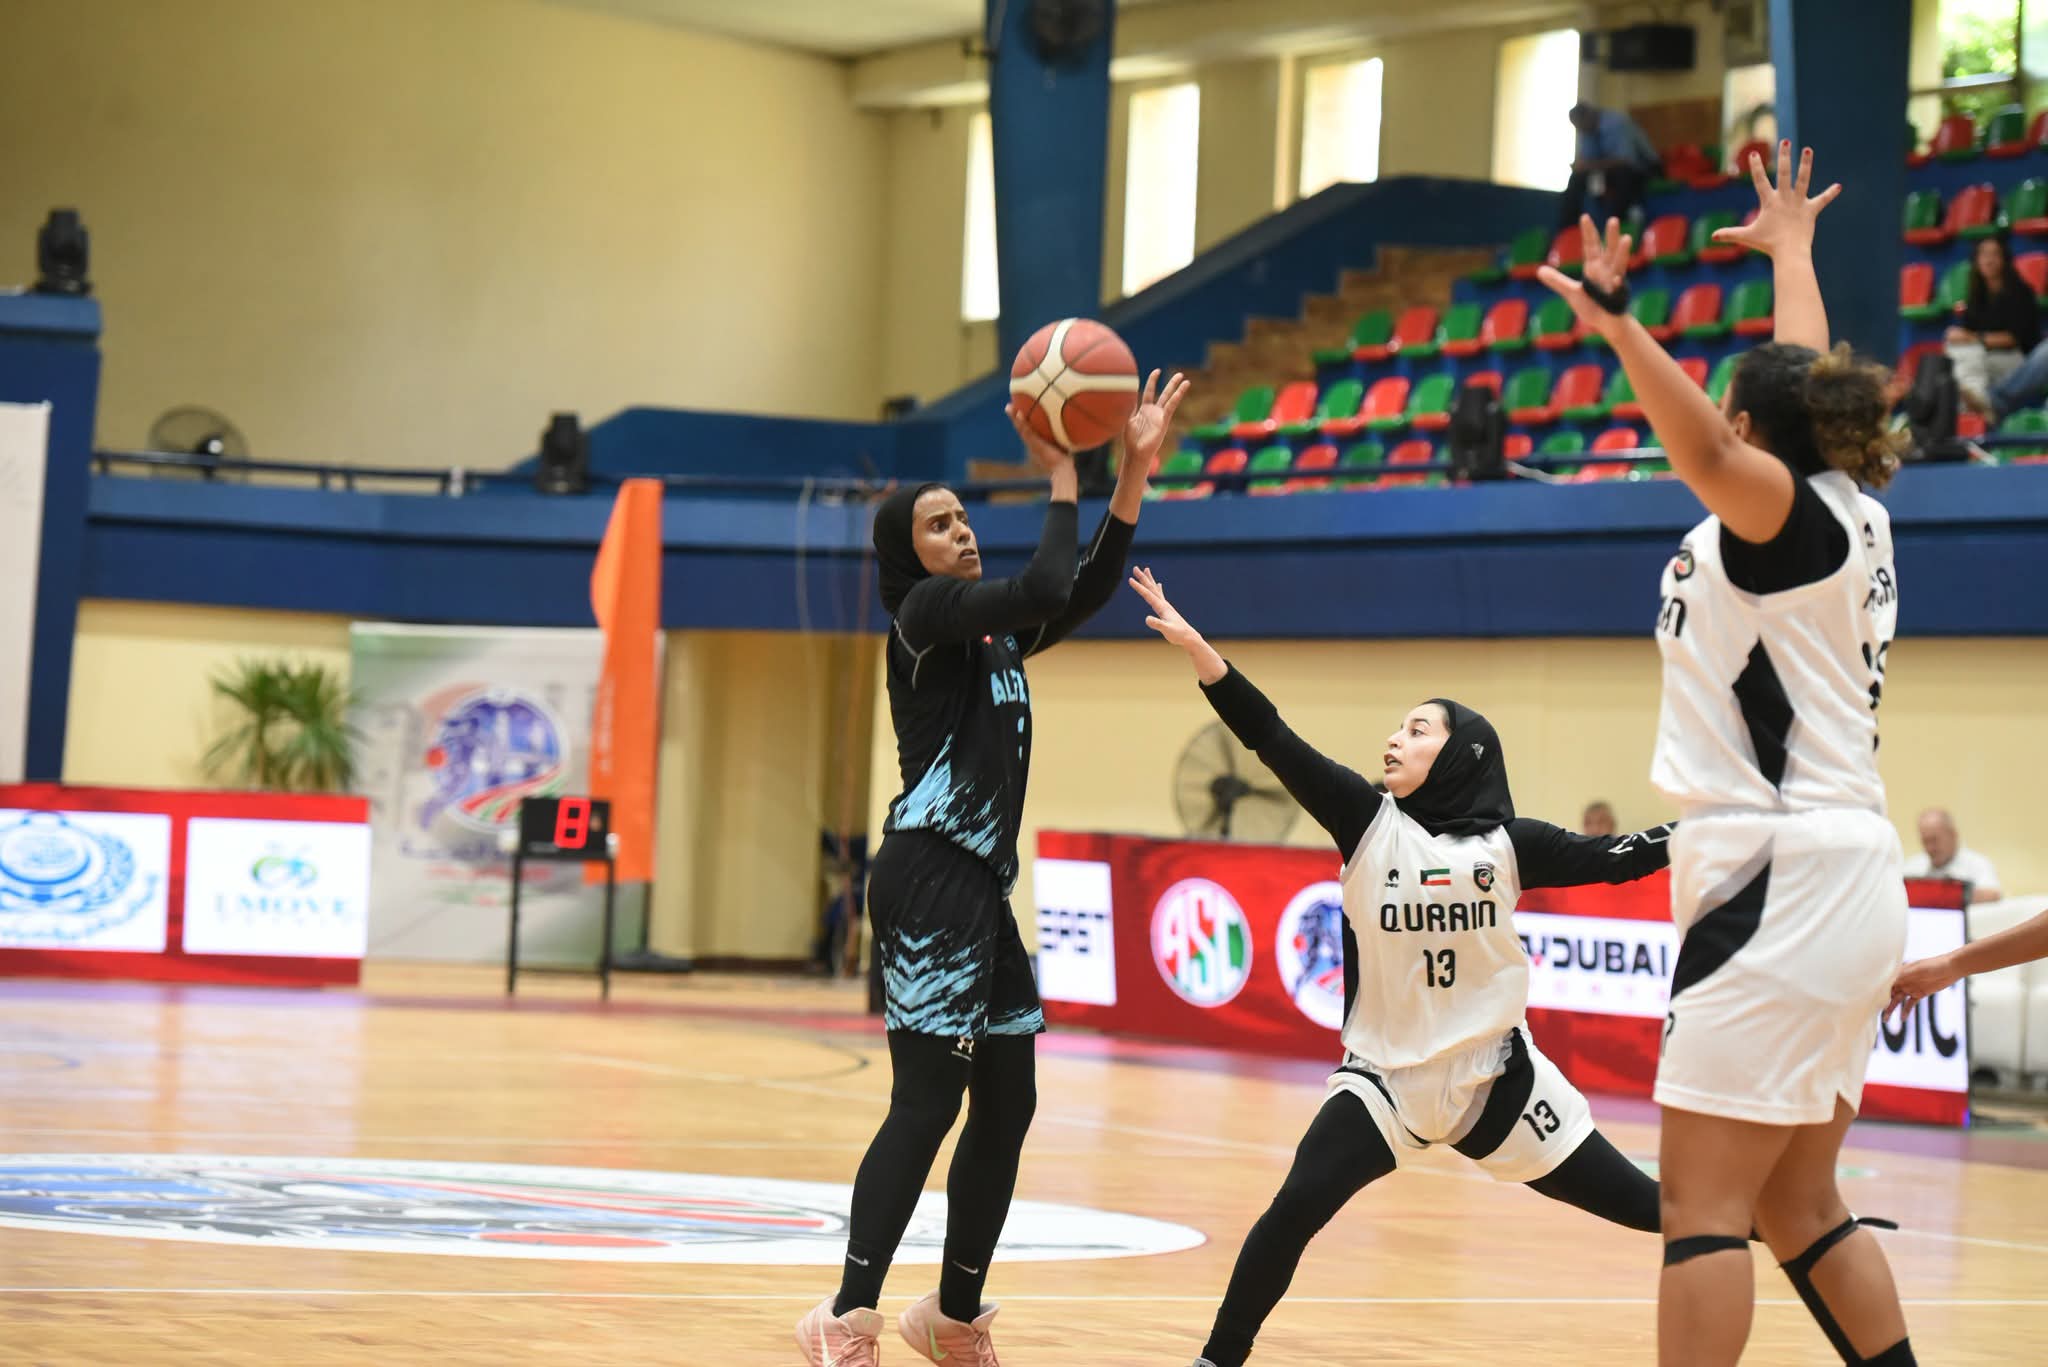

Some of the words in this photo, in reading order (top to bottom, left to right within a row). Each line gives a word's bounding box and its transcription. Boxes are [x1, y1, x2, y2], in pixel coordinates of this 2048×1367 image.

[554, 797, 590, 849] 8
[1380, 900, 1496, 933] QURAIN
[1163, 889, 1245, 998] ASC
[1422, 948, 1457, 988] 13
[1522, 1099, 1561, 1143] 13
